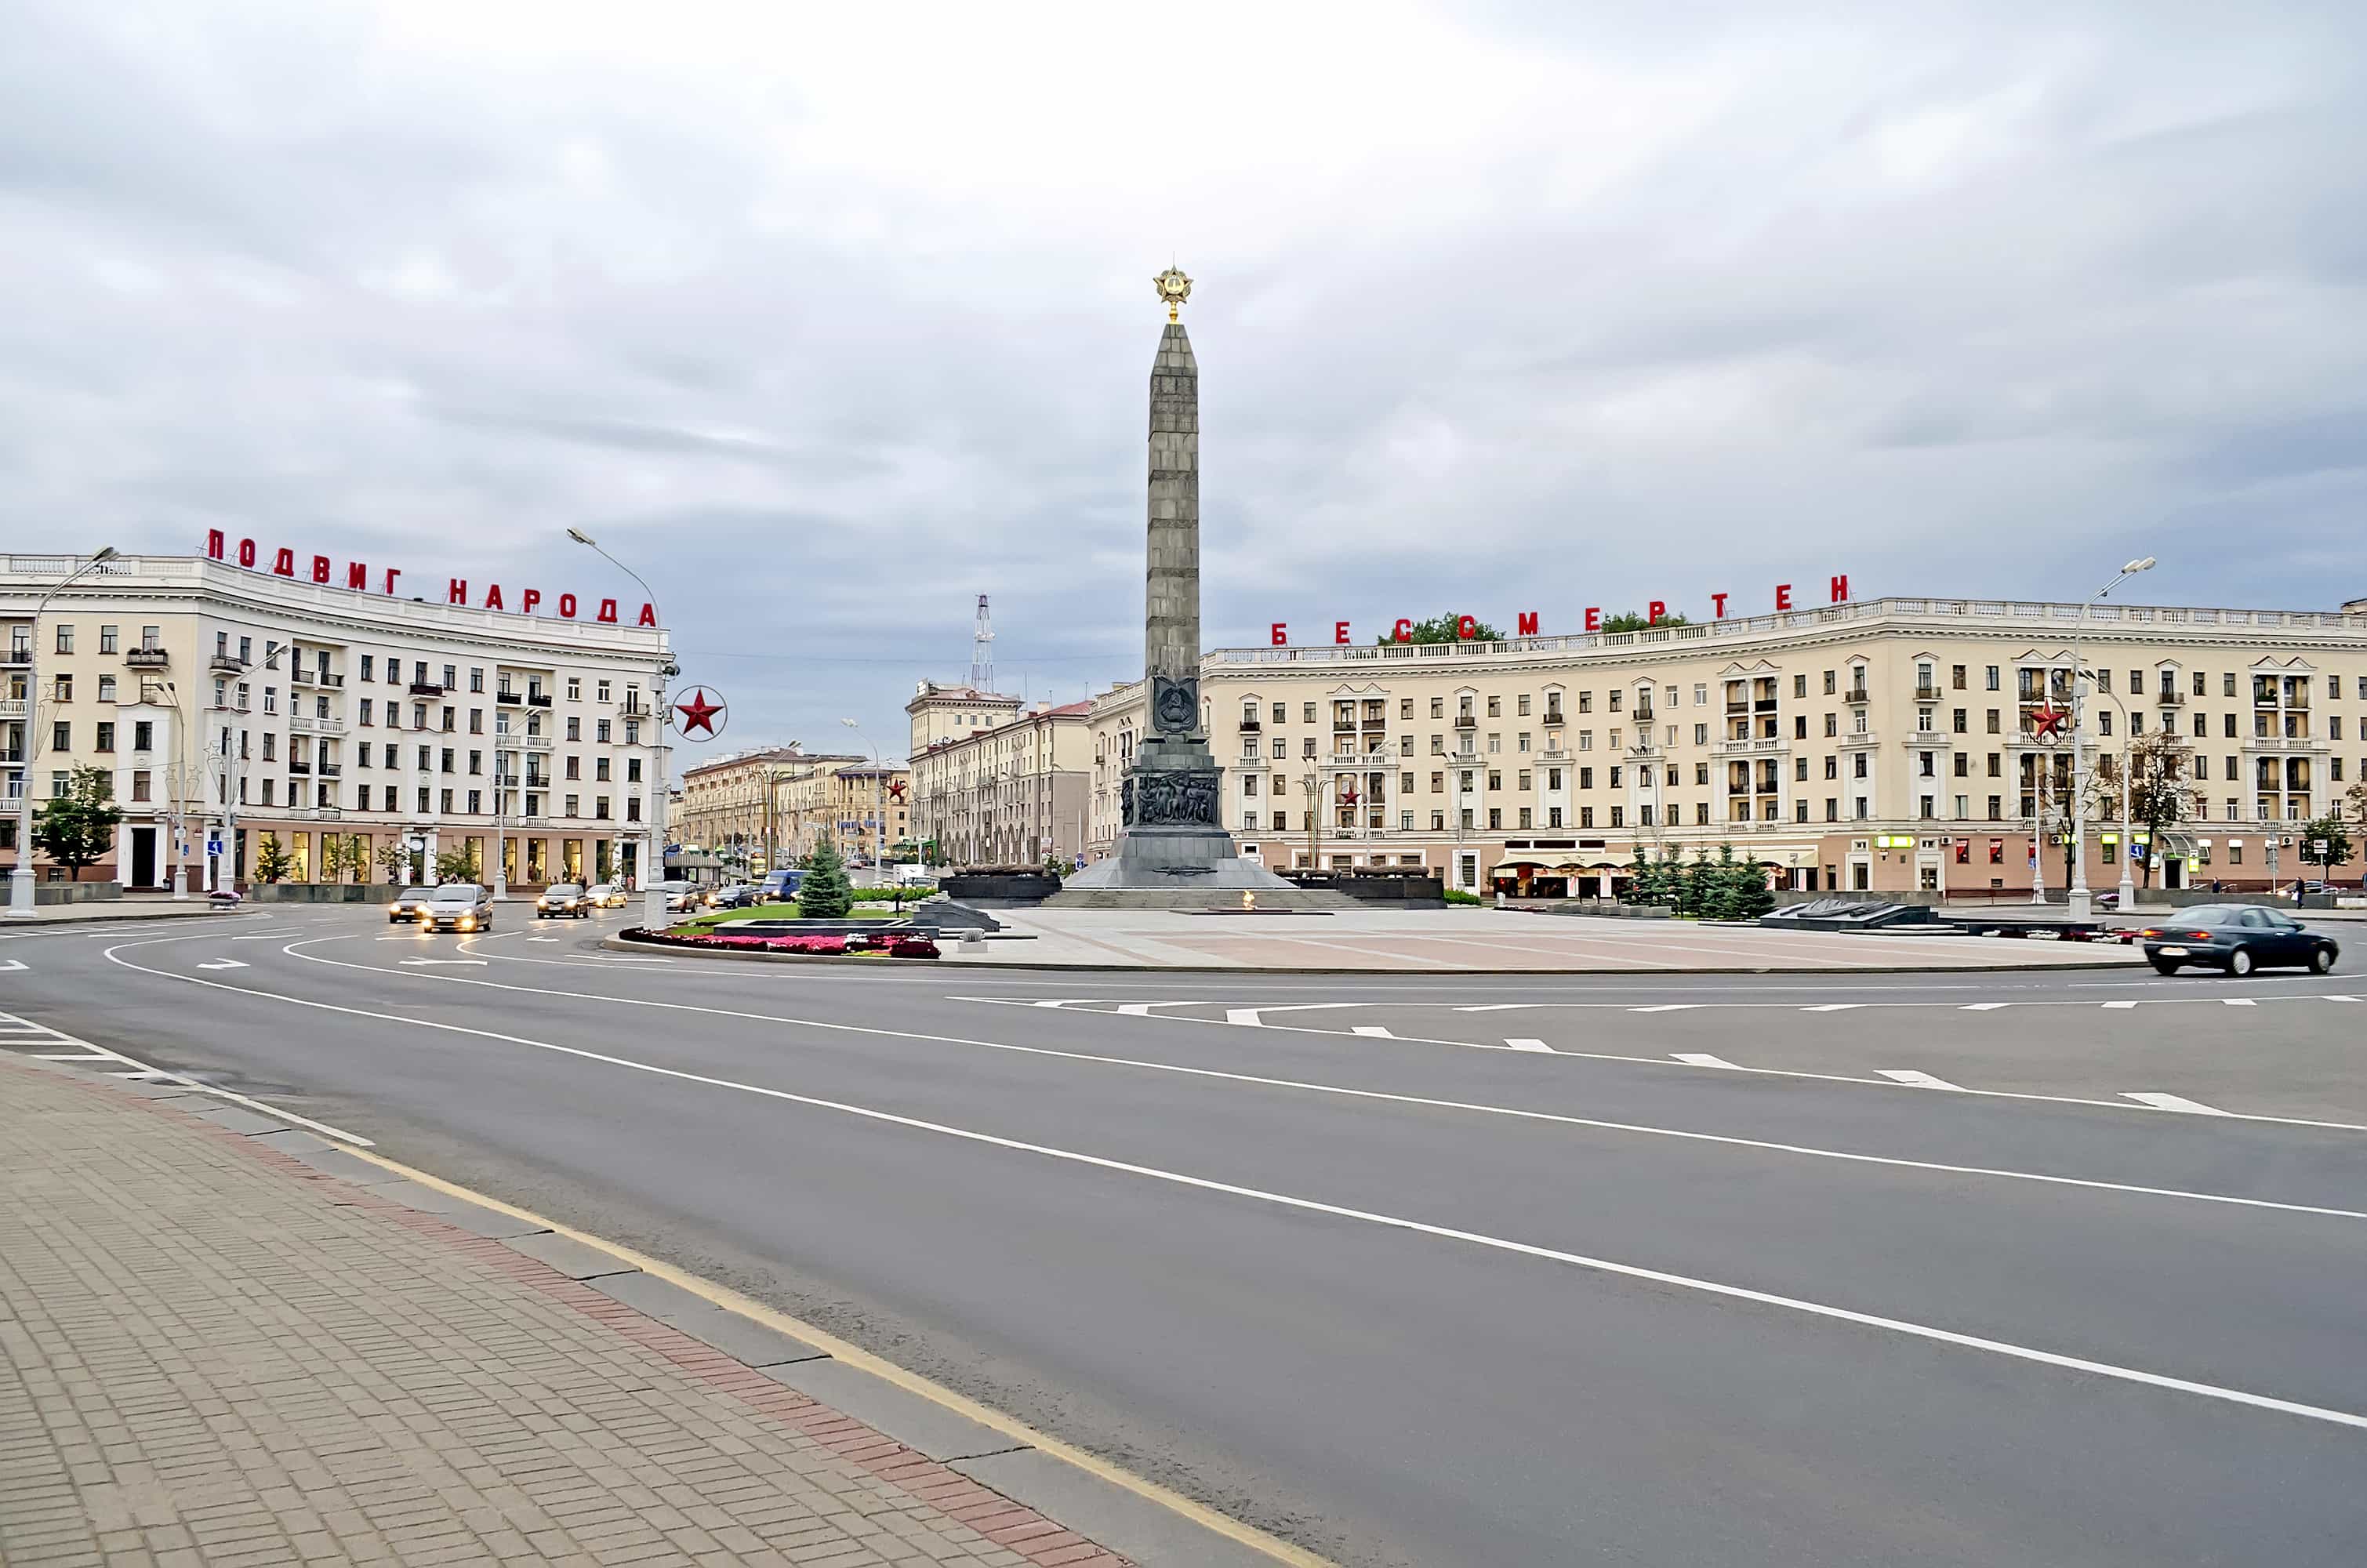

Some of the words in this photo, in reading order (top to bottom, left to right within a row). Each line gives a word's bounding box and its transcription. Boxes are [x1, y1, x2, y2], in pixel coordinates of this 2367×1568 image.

[208, 528, 401, 594] ПОДВИГ
[449, 579, 656, 627] НАРОДА
[1271, 575, 1850, 646] БЕССМЕРТЕН
